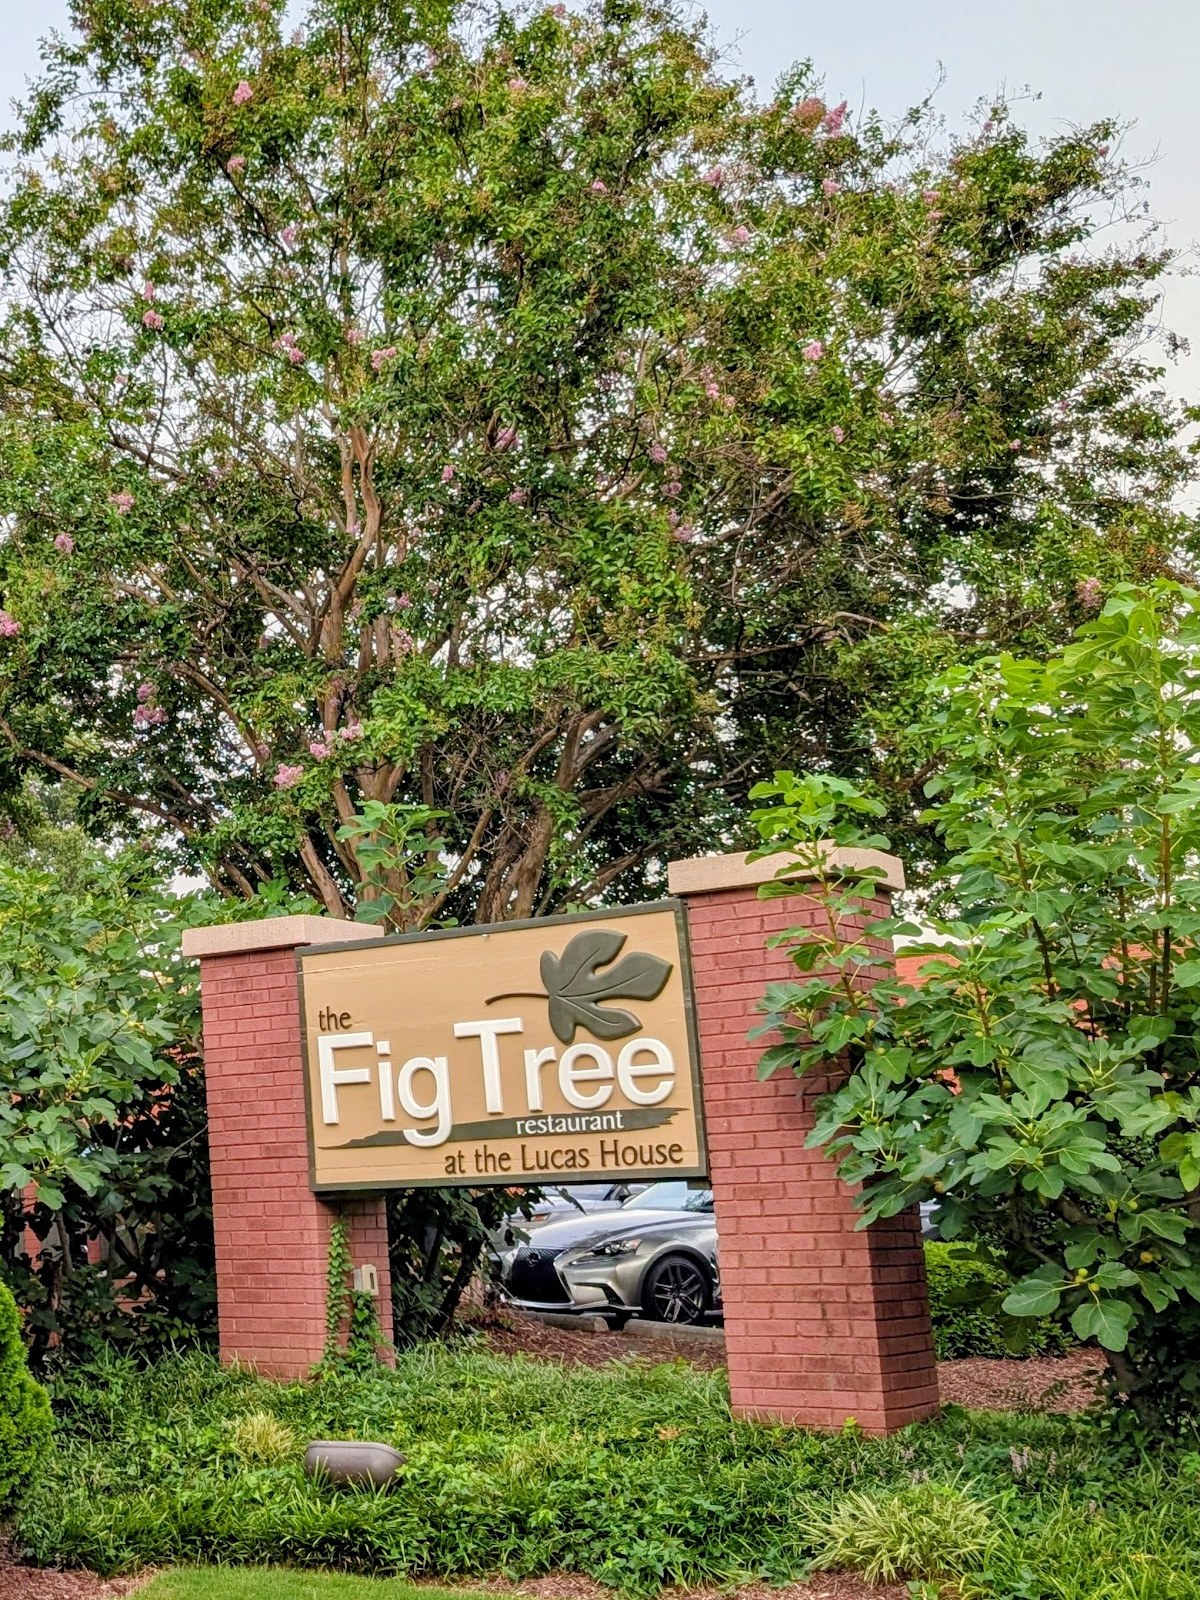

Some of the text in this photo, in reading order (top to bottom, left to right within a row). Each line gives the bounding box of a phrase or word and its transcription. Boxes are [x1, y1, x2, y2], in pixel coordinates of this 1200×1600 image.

[318, 1006, 352, 1031] the
[317, 1017, 676, 1148] Fig Tree
[515, 1110, 625, 1136] restaurant
[444, 1139, 684, 1175] at the Lucas House
